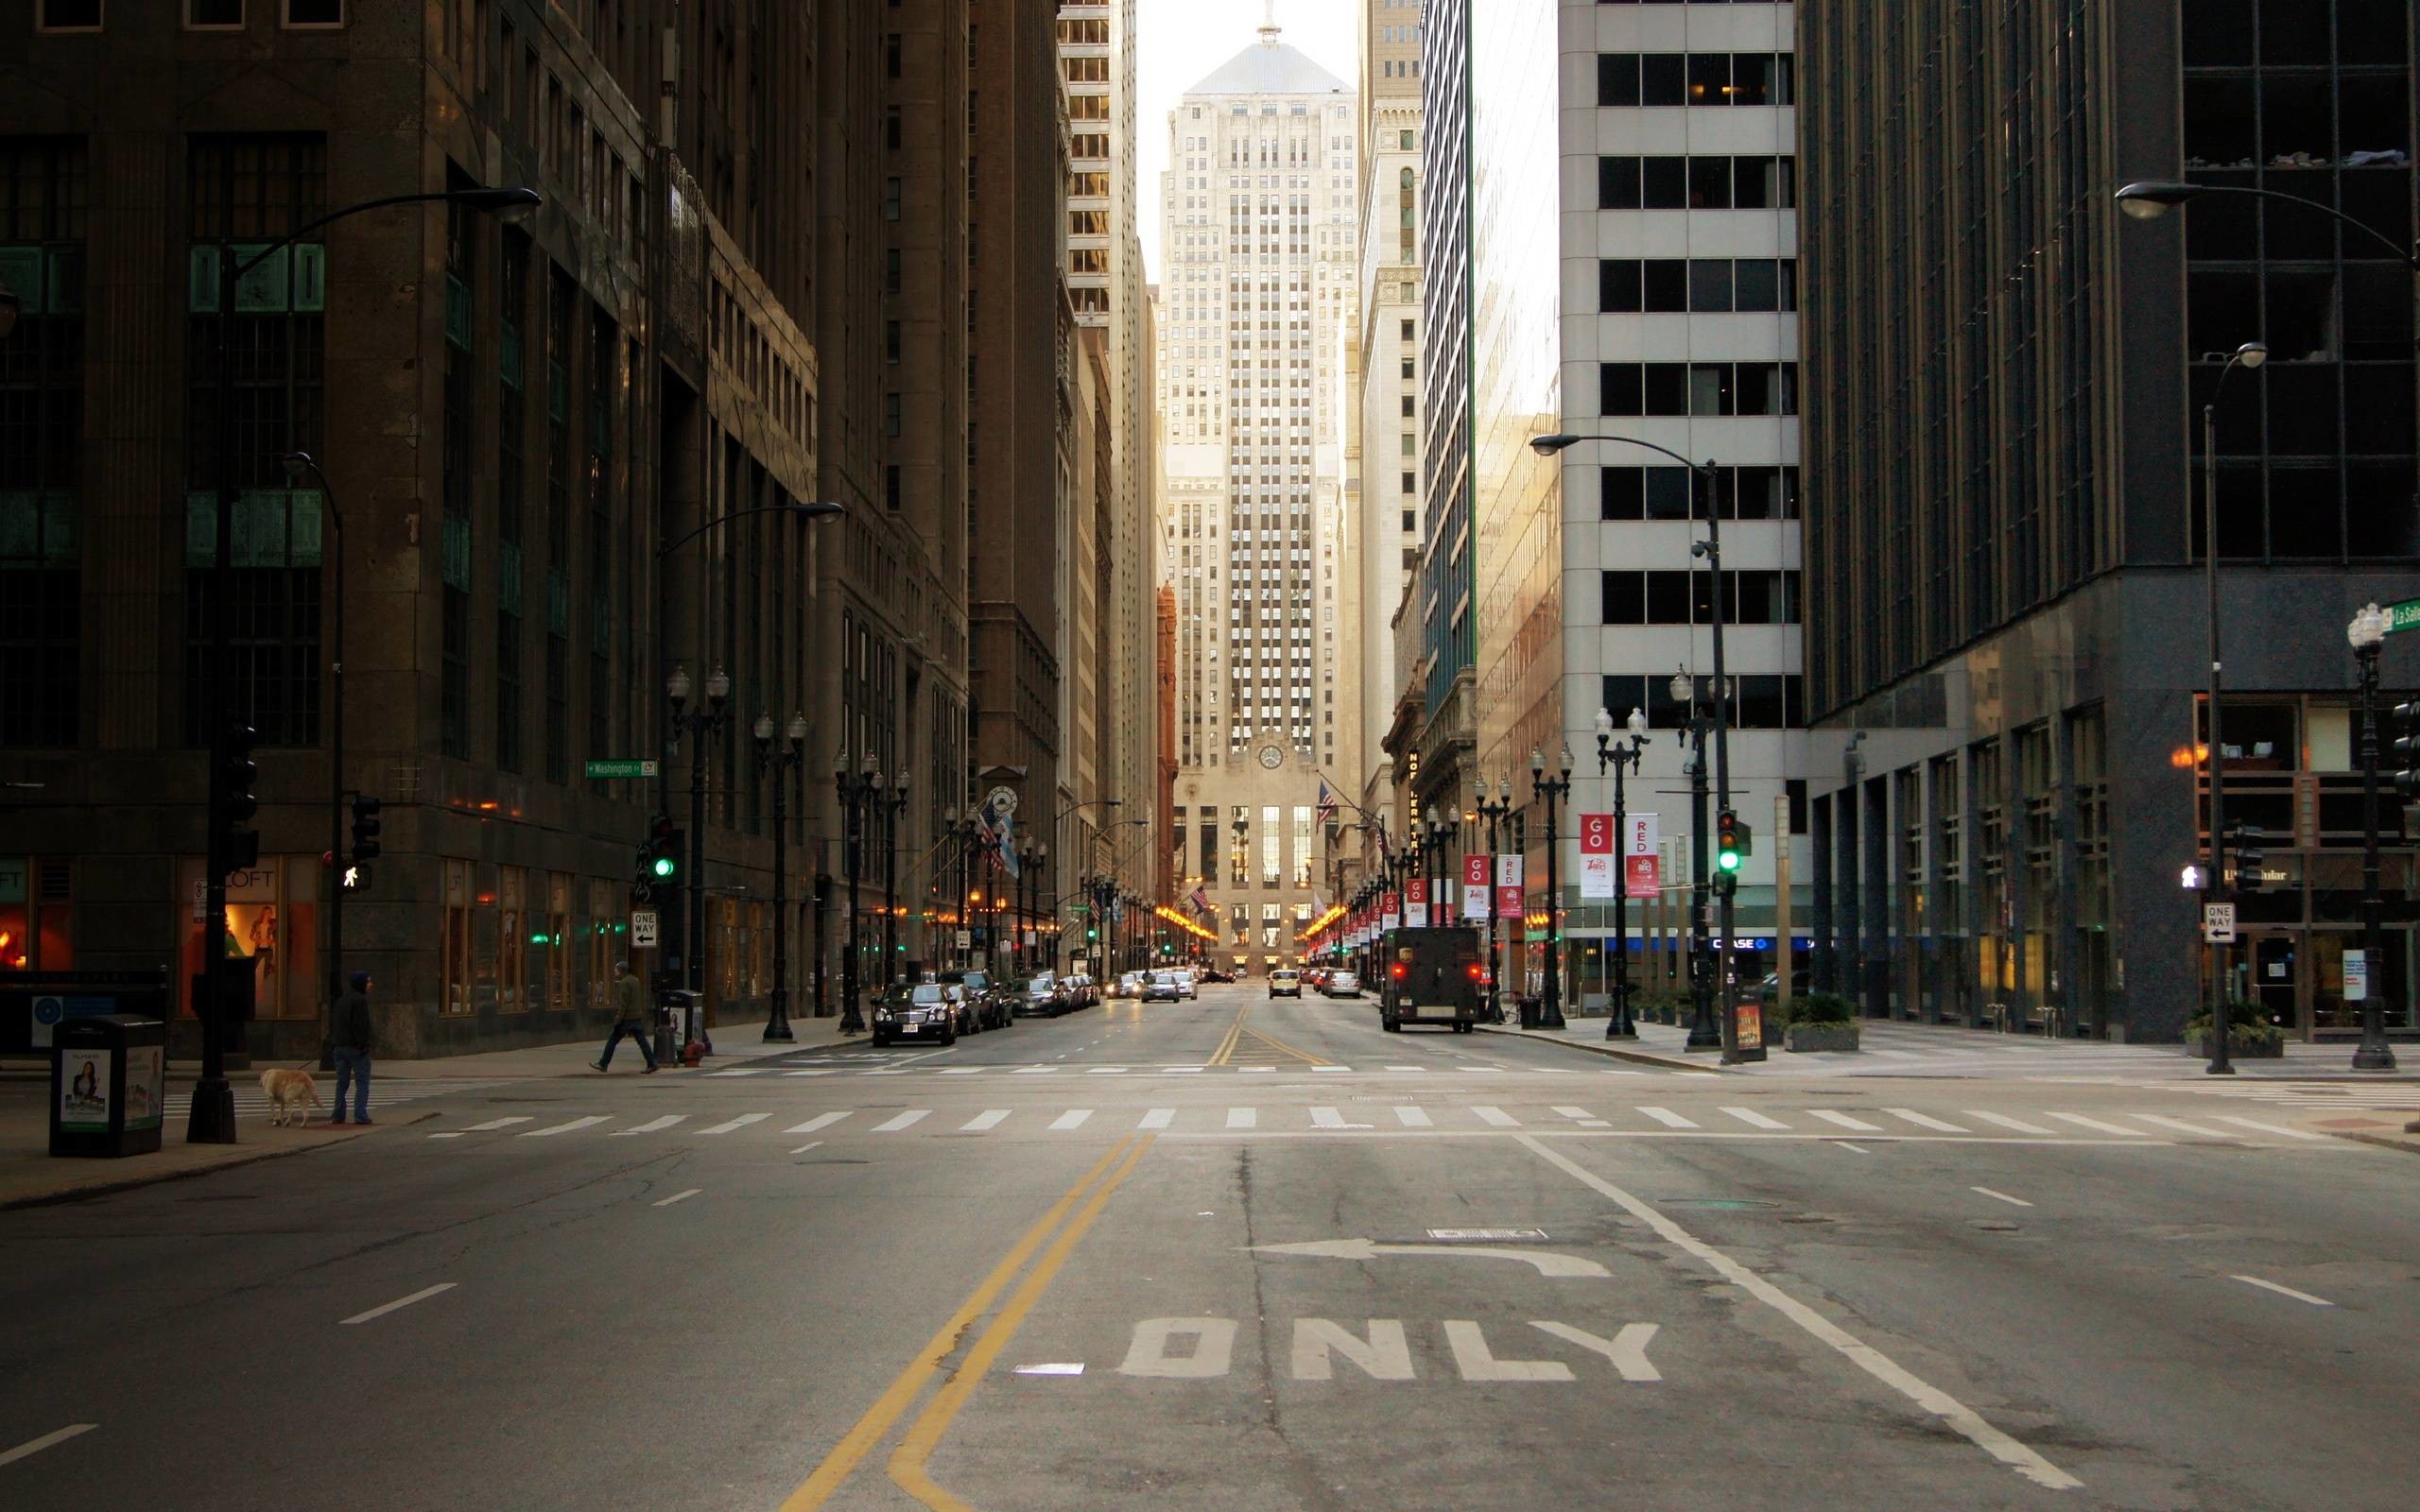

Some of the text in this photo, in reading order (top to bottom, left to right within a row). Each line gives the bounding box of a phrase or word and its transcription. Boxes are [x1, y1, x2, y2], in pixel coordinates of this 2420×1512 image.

[594, 763, 632, 776] Washington
[1589, 819, 1603, 848] GO
[1636, 821, 1647, 852] RED
[1471, 859, 1482, 882] GO
[1505, 860, 1513, 885] RED
[1412, 883, 1421, 900] GO
[1387, 897, 1394, 912] GO
[2208, 907, 2231, 917] ONE
[635, 914, 655, 923] ONE
[2208, 918, 2231, 927] WAY
[635, 924, 654, 933] WAY
[1713, 939, 1754, 949] CASE
[1116, 1317, 1663, 1383] ONLY
